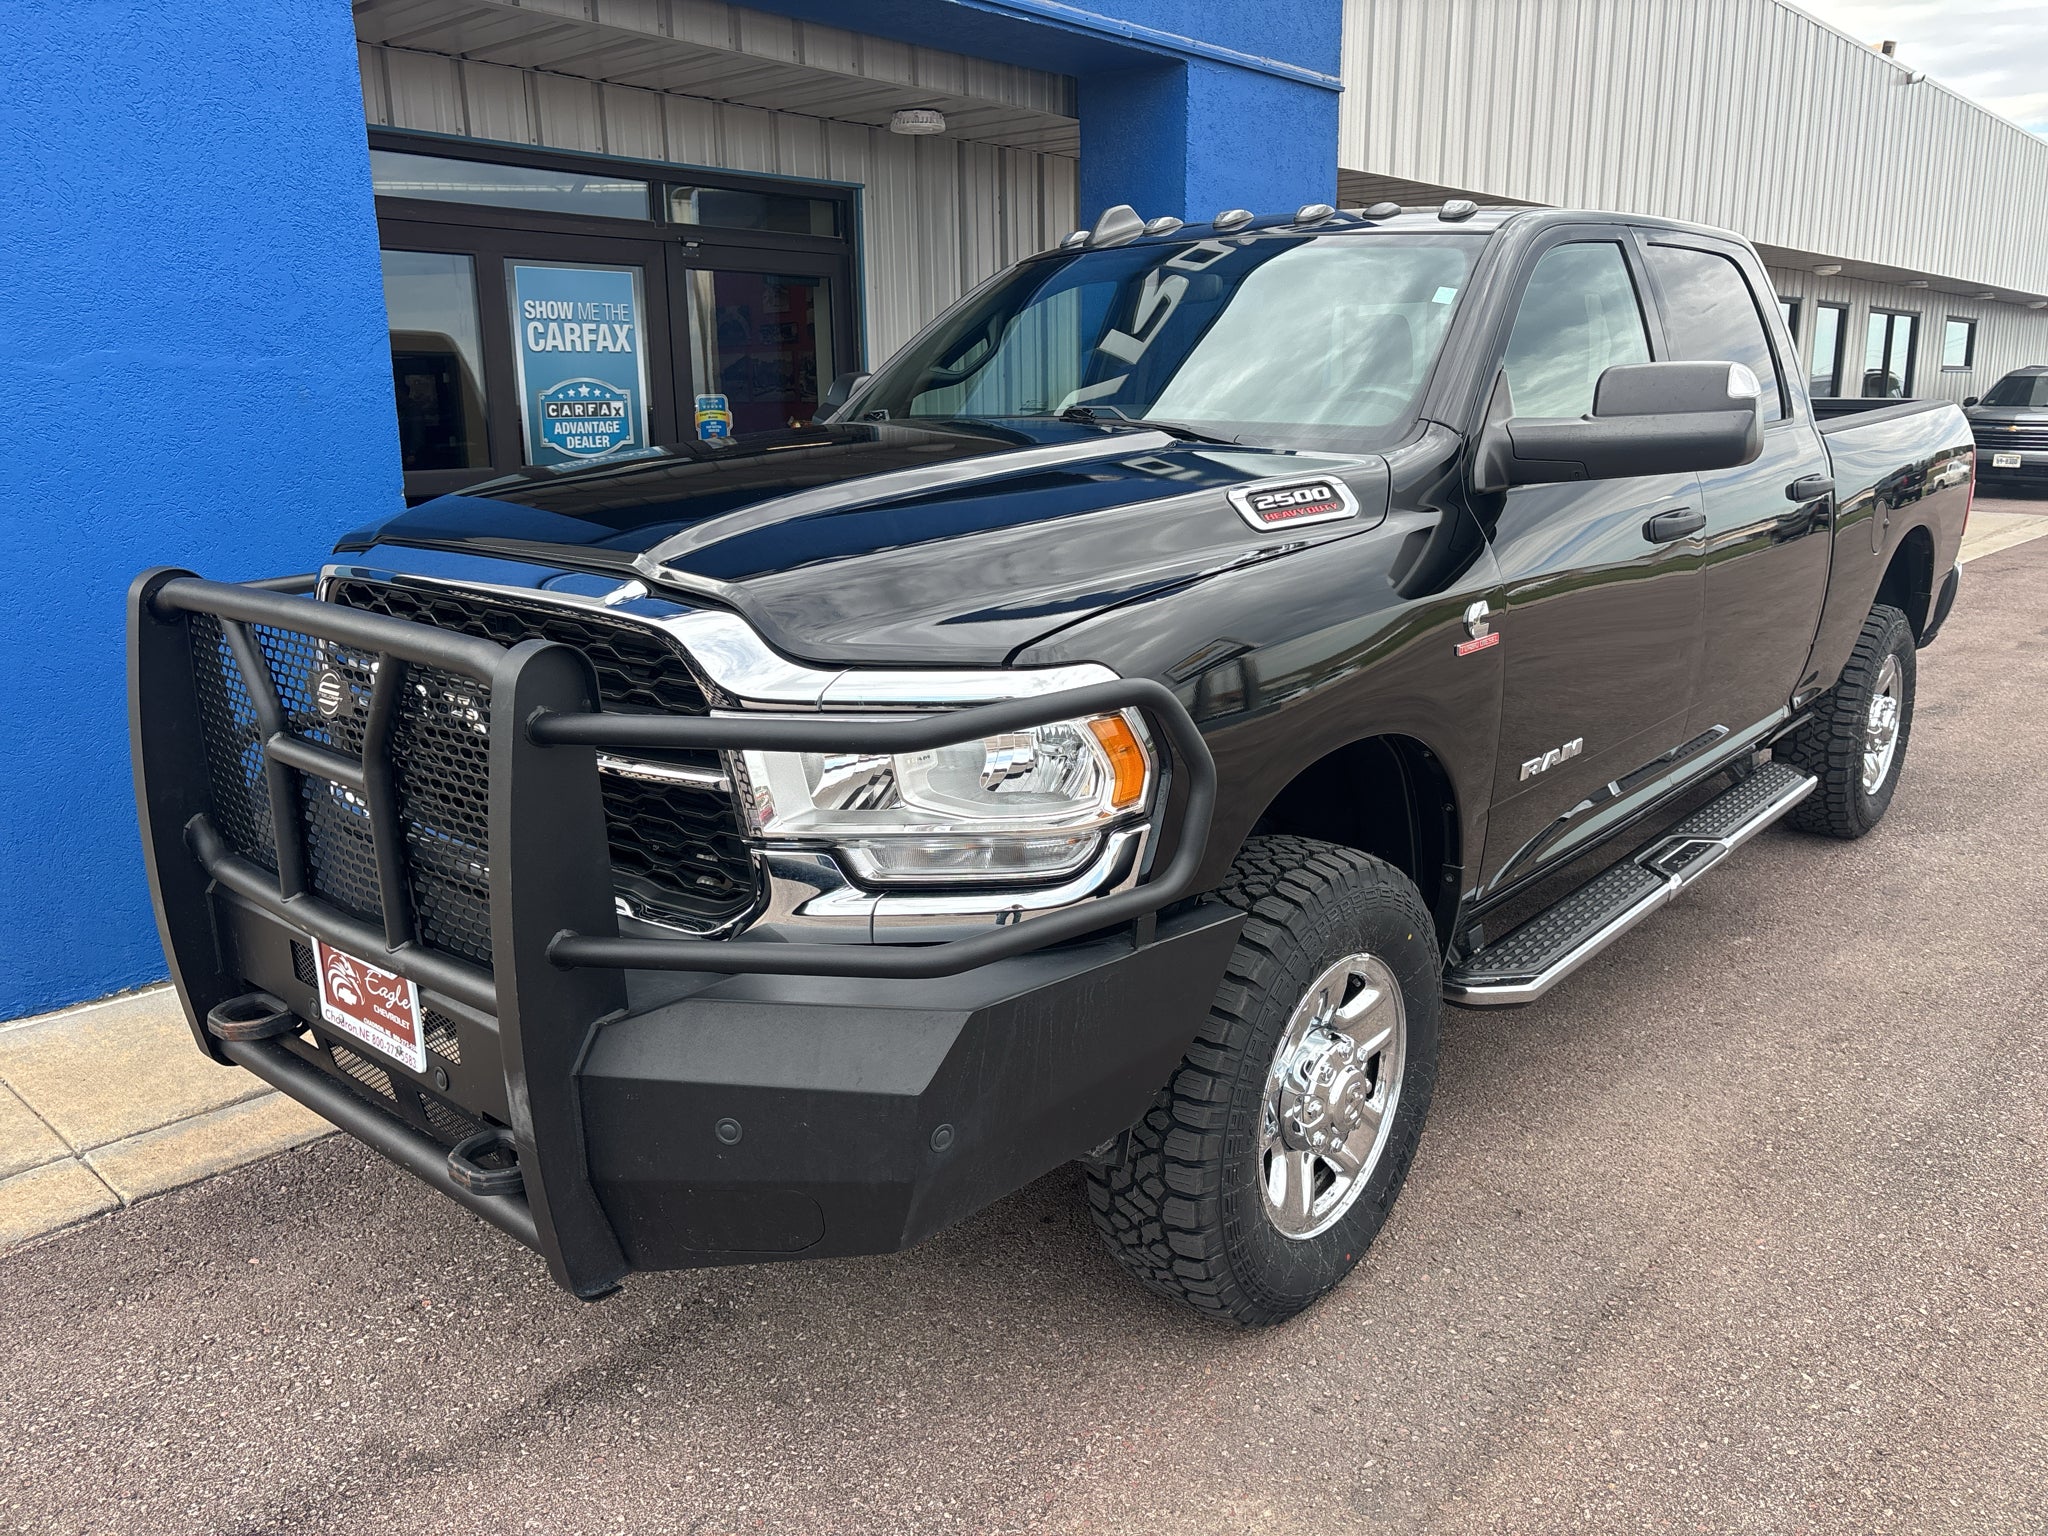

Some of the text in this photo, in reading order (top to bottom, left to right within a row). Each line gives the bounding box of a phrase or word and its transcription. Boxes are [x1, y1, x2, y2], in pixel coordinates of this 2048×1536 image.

[524, 300, 630, 322] SHOW ME THE
[547, 401, 624, 418] CARFAX
[554, 421, 620, 435] ADVANTAGE
[566, 435, 610, 449] DEALER
[1253, 487, 1331, 510] 2500
[1263, 503, 1337, 521] HEAVY DUTY
[1519, 737, 1584, 781] RAM
[364, 969, 411, 1010] Eagle
[373, 1004, 410, 1030] CHEVROLET
